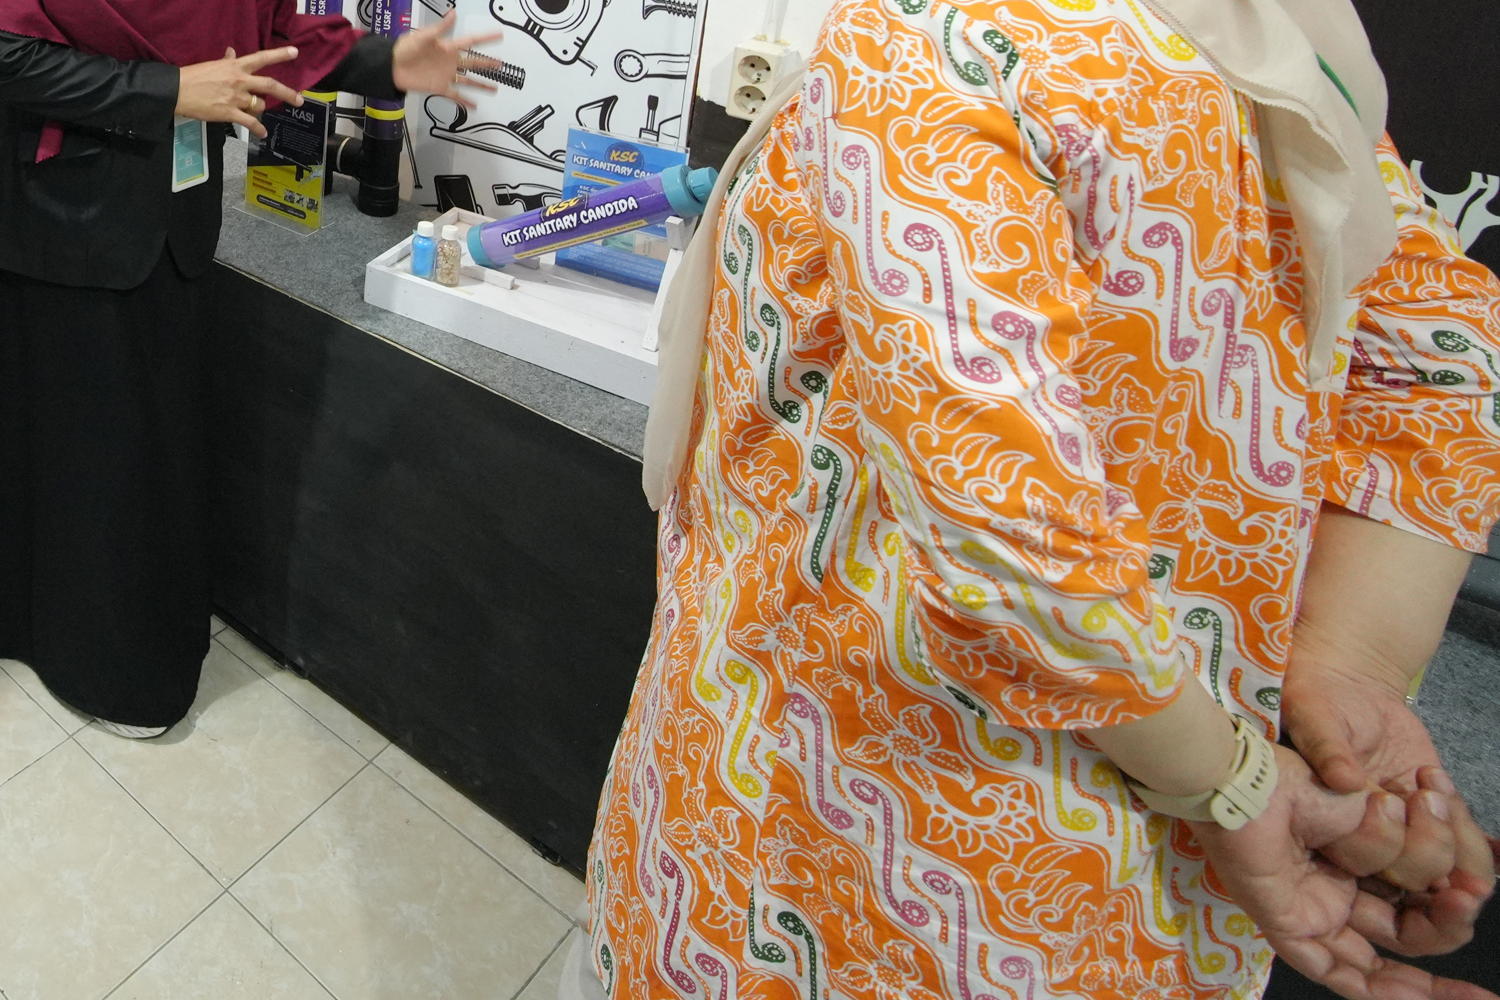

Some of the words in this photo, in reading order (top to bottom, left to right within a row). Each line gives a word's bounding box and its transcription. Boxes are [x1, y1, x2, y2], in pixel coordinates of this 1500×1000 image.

[383, 9, 393, 31] USRF
[291, 107, 315, 123] KASI
[573, 155, 589, 166] KIT
[589, 158, 633, 176] SANITARY
[610, 150, 639, 163] KSC
[545, 196, 580, 217] KSC
[502, 230, 522, 246] KIT
[522, 209, 579, 242] SANITARY
[579, 196, 639, 225] CANDIDA
